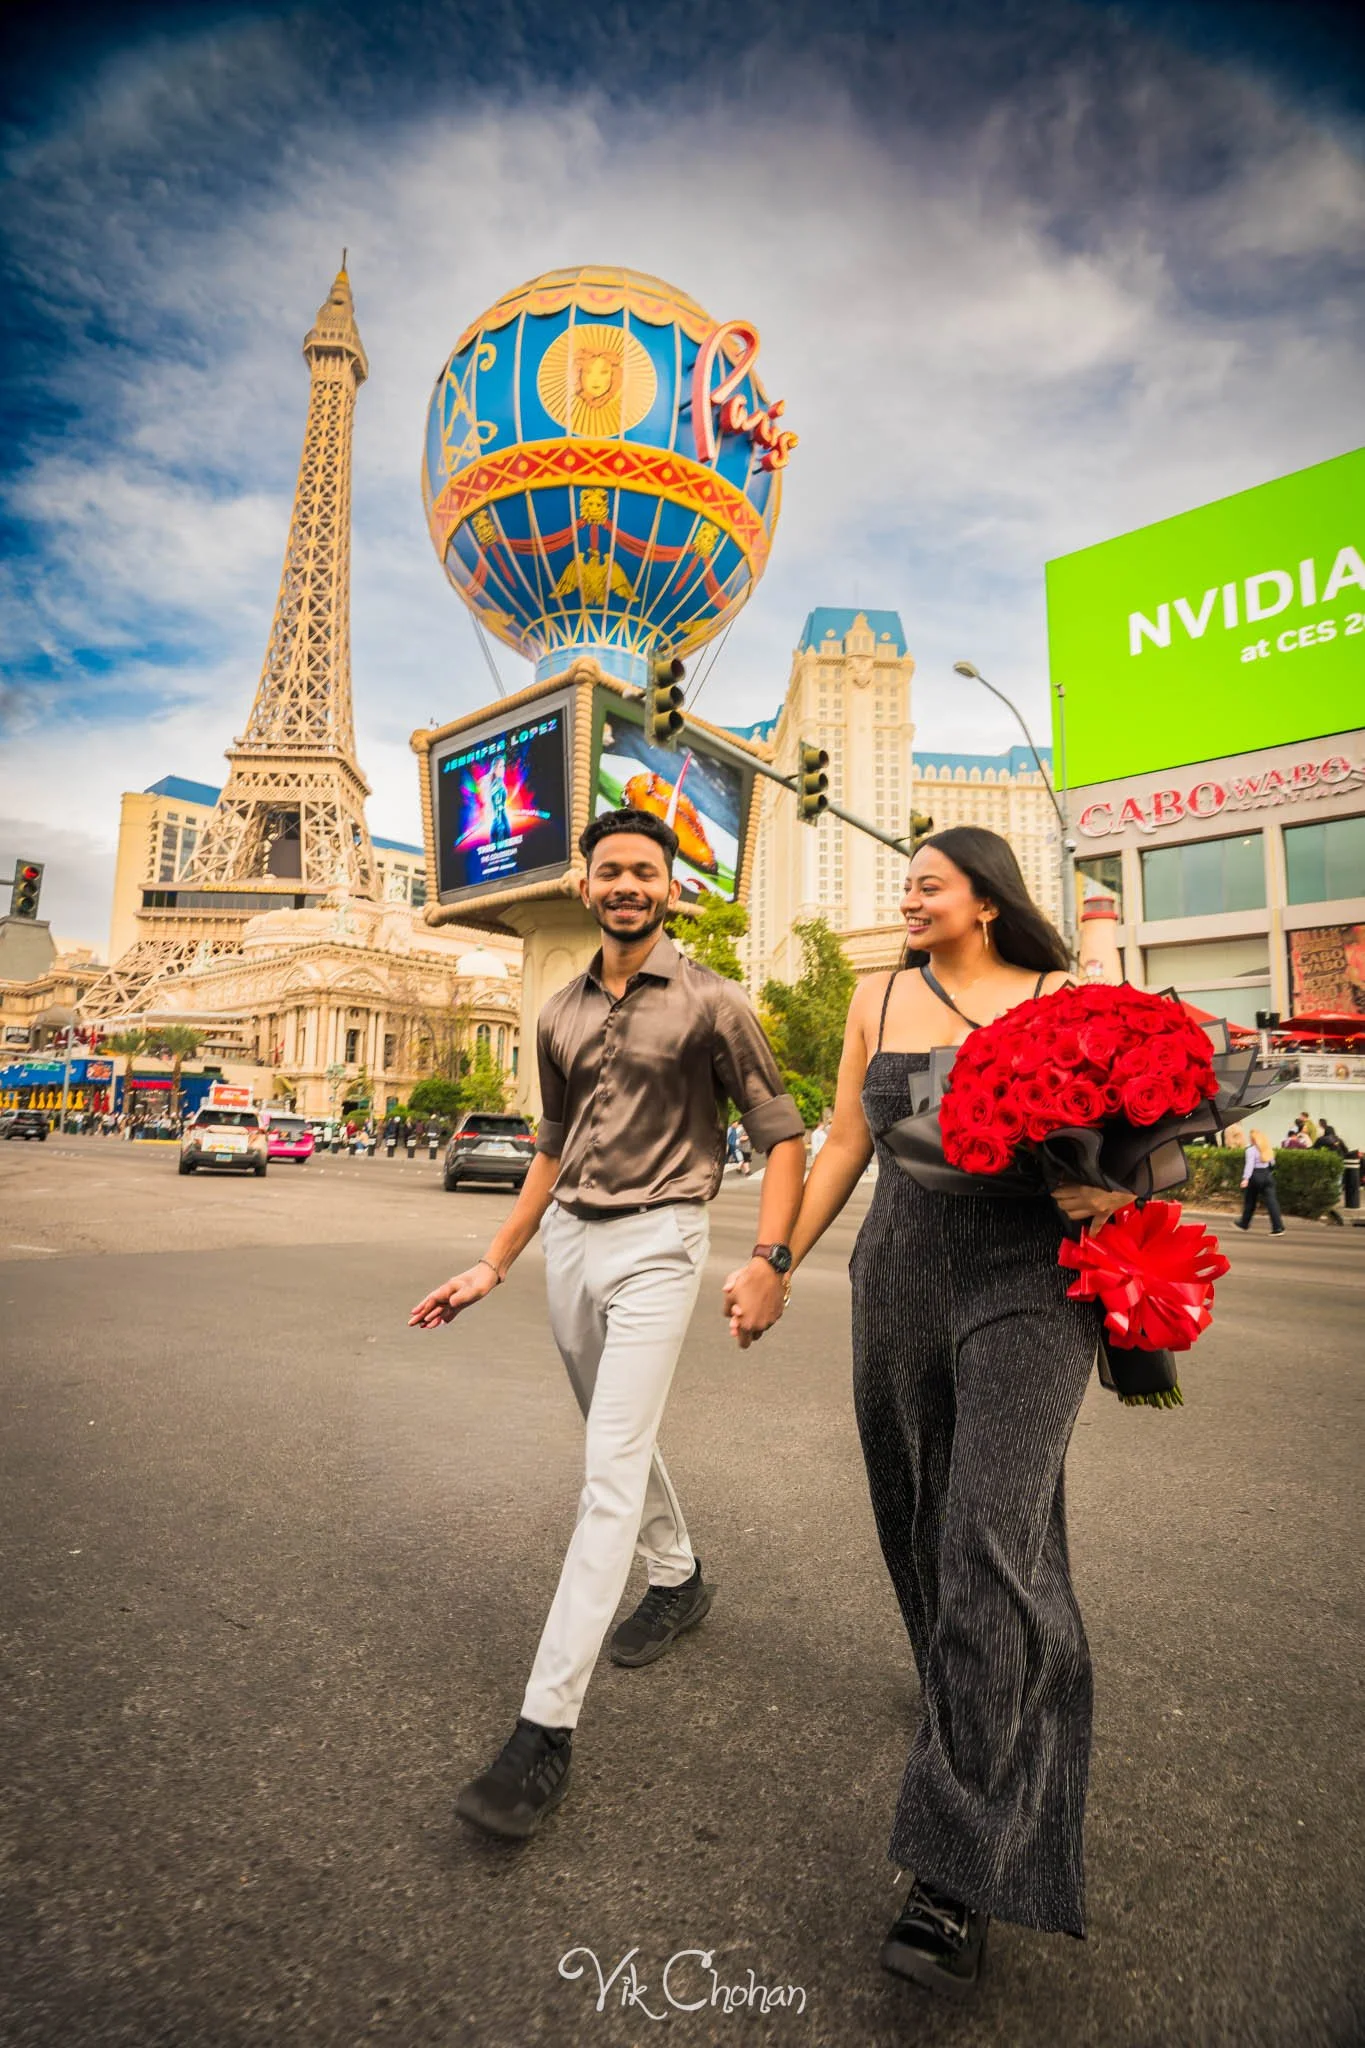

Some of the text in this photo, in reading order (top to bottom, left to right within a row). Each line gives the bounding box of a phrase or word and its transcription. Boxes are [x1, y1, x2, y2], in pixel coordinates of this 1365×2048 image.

[691, 320, 799, 472] Paris
[1128, 545, 1365, 657] NVIDIA
[1240, 612, 1365, 664] at CES 2
[443, 718, 558, 774] JENNIFER LOPEZ
[1076, 755, 1352, 837] CABO WABO
[1299, 949, 1344, 966] CABO
